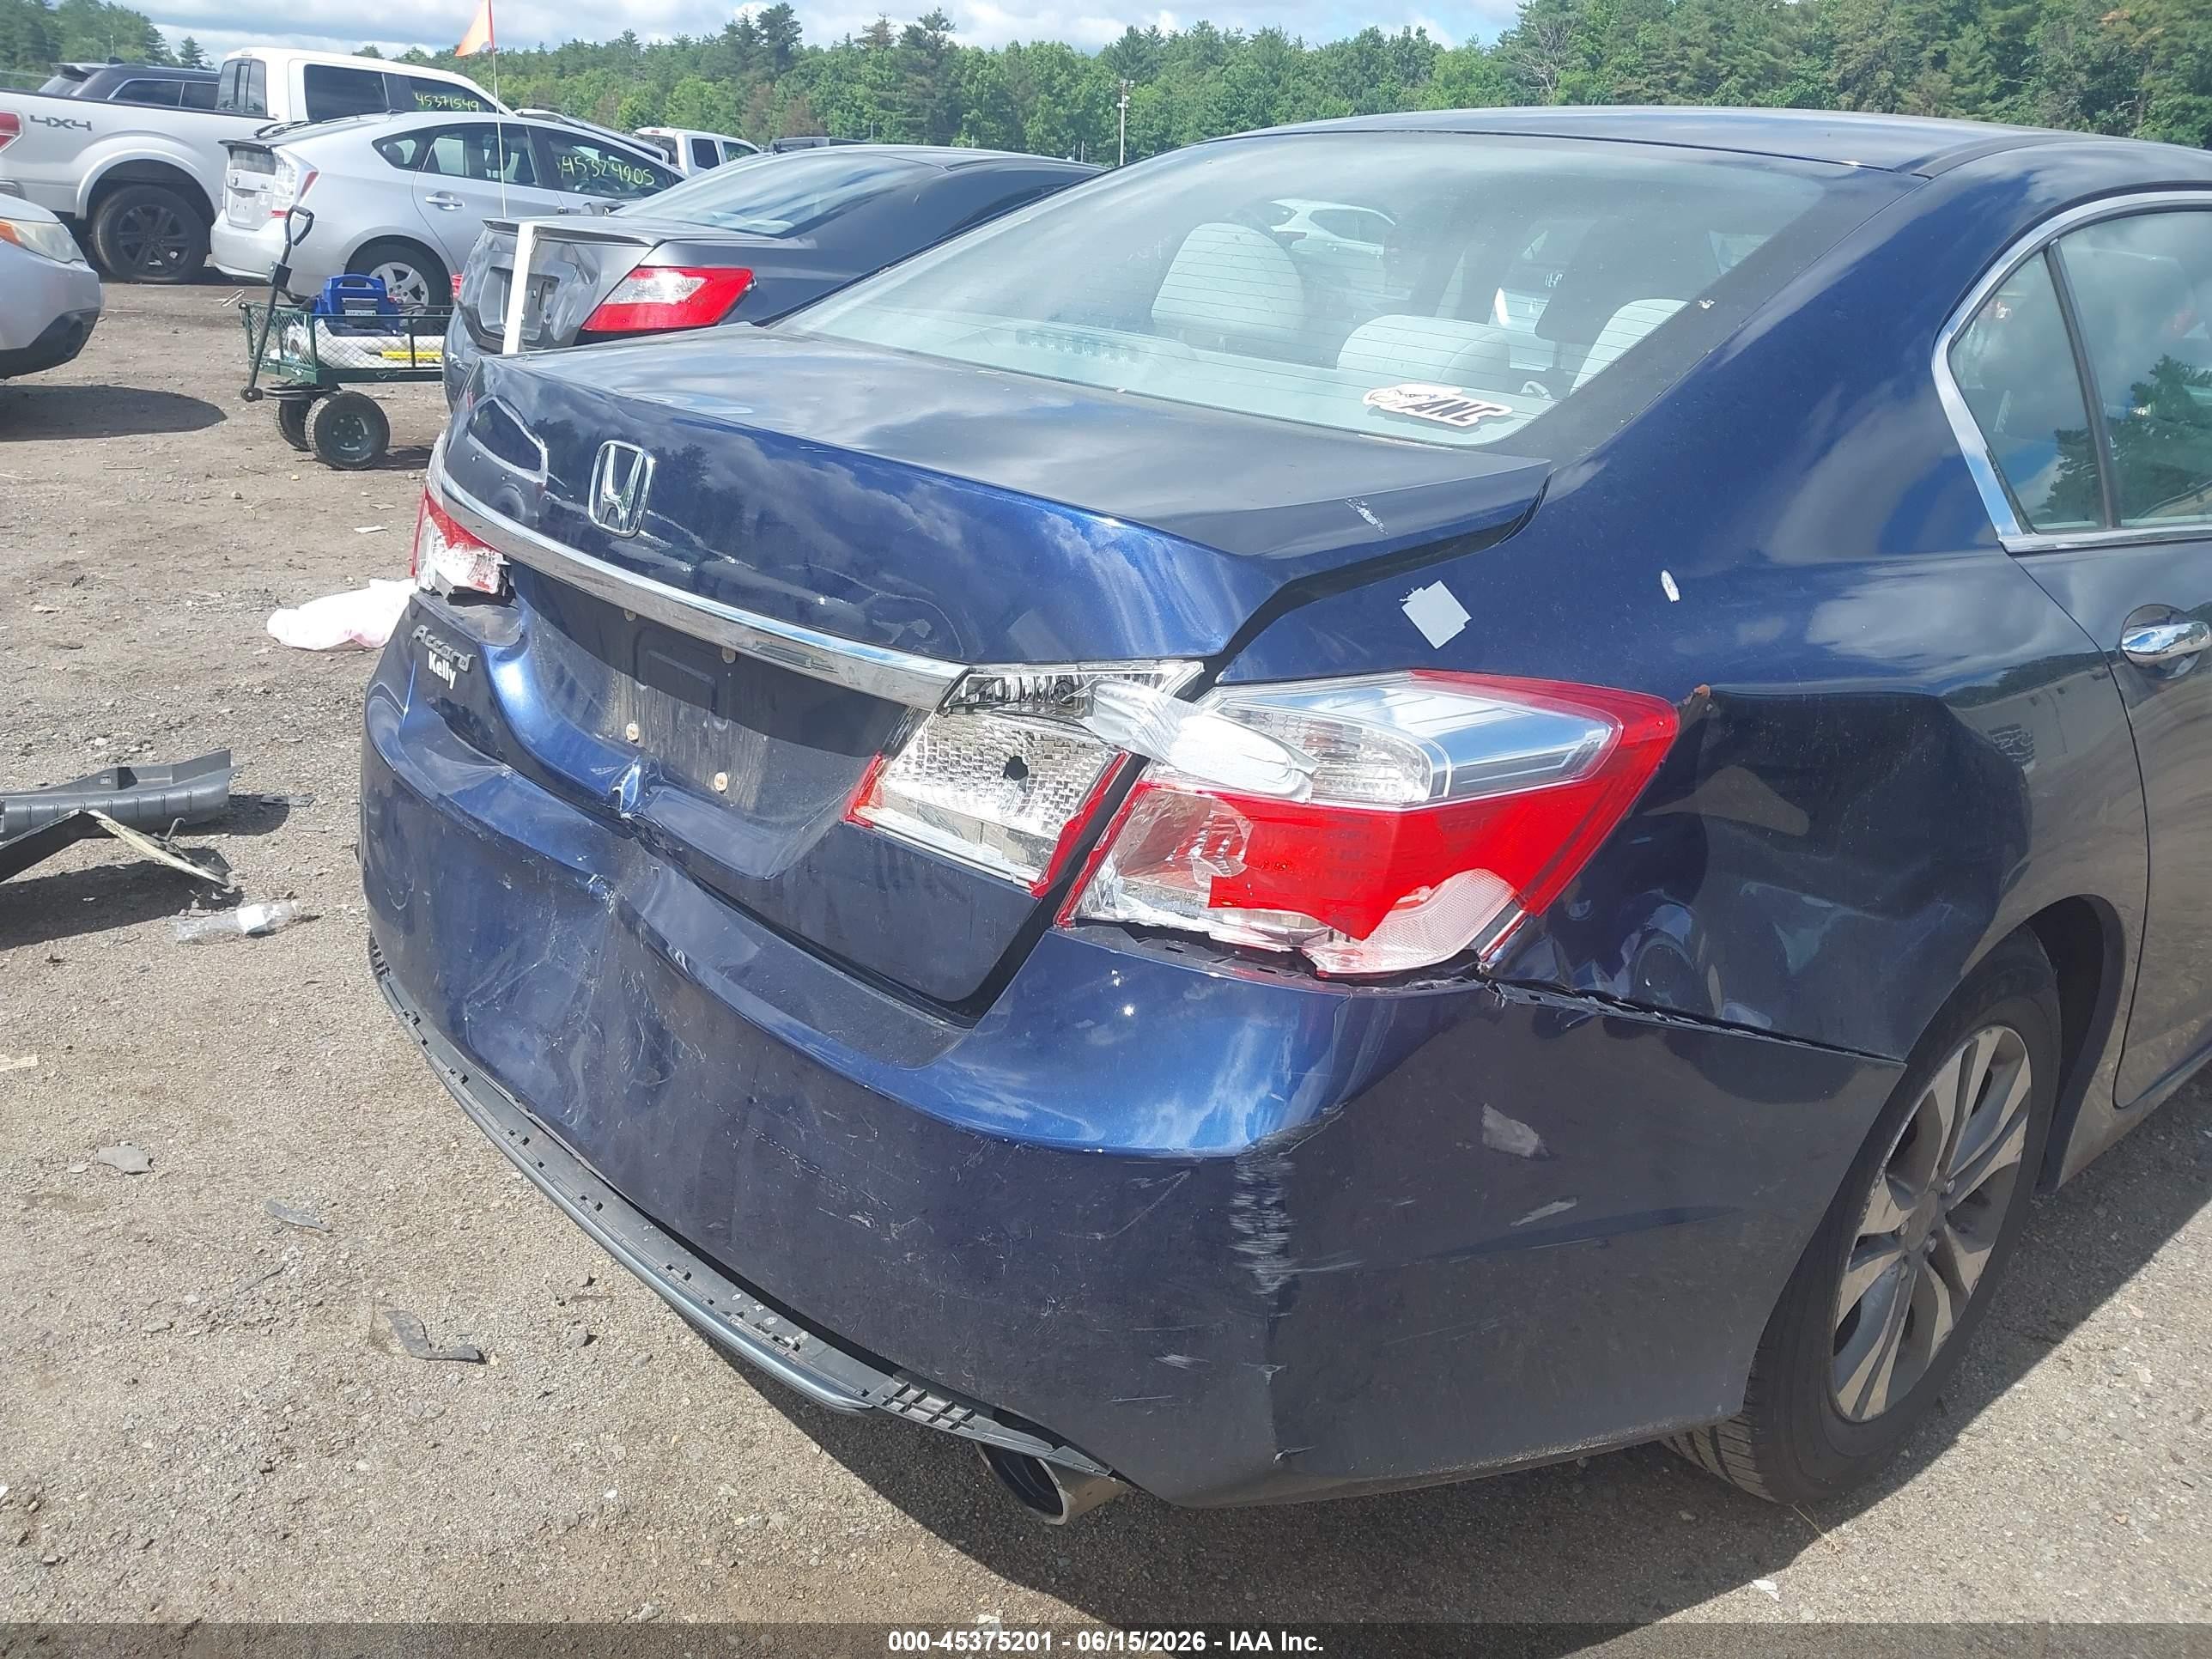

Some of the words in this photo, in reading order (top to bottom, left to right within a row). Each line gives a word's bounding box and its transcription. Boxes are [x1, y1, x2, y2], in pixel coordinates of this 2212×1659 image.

[415, 92, 479, 112] 45371549
[561, 155, 655, 185] 45324905
[412, 624, 477, 673] Accord
[428, 650, 457, 690] Kelly
